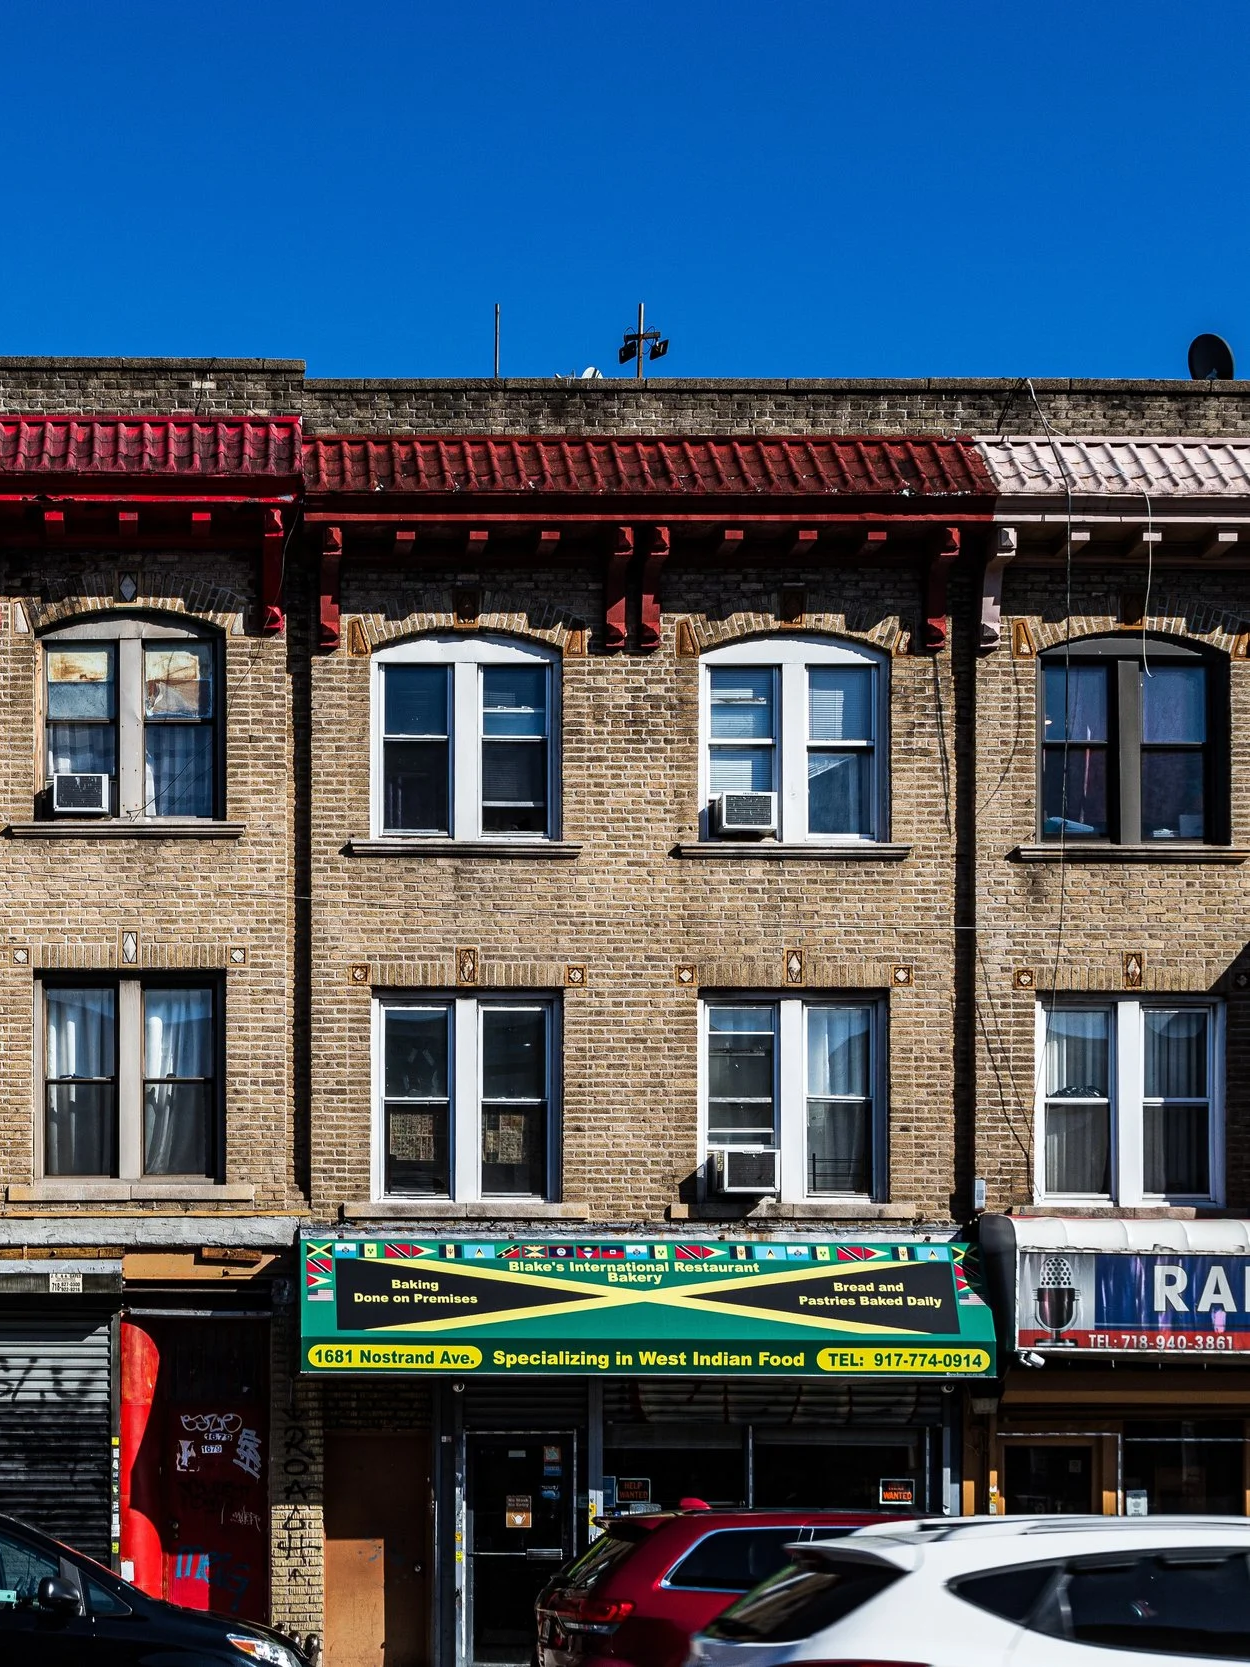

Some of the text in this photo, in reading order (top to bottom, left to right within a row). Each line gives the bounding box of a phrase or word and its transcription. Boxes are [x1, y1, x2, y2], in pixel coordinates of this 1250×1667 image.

[508, 1261, 760, 1273] Blake's International Restaurant
[607, 1272, 662, 1285] Bakery
[391, 1279, 439, 1292] Baking
[833, 1282, 904, 1292] Bread and
[1153, 1265, 1250, 1312] RA
[354, 1293, 478, 1304] Done on Premises
[799, 1296, 942, 1308] Pastries Baked Daily
[1089, 1334, 1234, 1350] TEL: 718-940-3861
[315, 1349, 475, 1365] 1681 Nostrand Ave.
[493, 1350, 805, 1369] Specializing in West Indian Food
[828, 1353, 982, 1368] TEL: 917-774-0914
[204, 1433, 233, 1442] 1679
[201, 1445, 223, 1454] 1679
[624, 1481, 643, 1490] HELP
[619, 1490, 648, 1499] WANTED
[883, 1491, 912, 1500] WANTED
